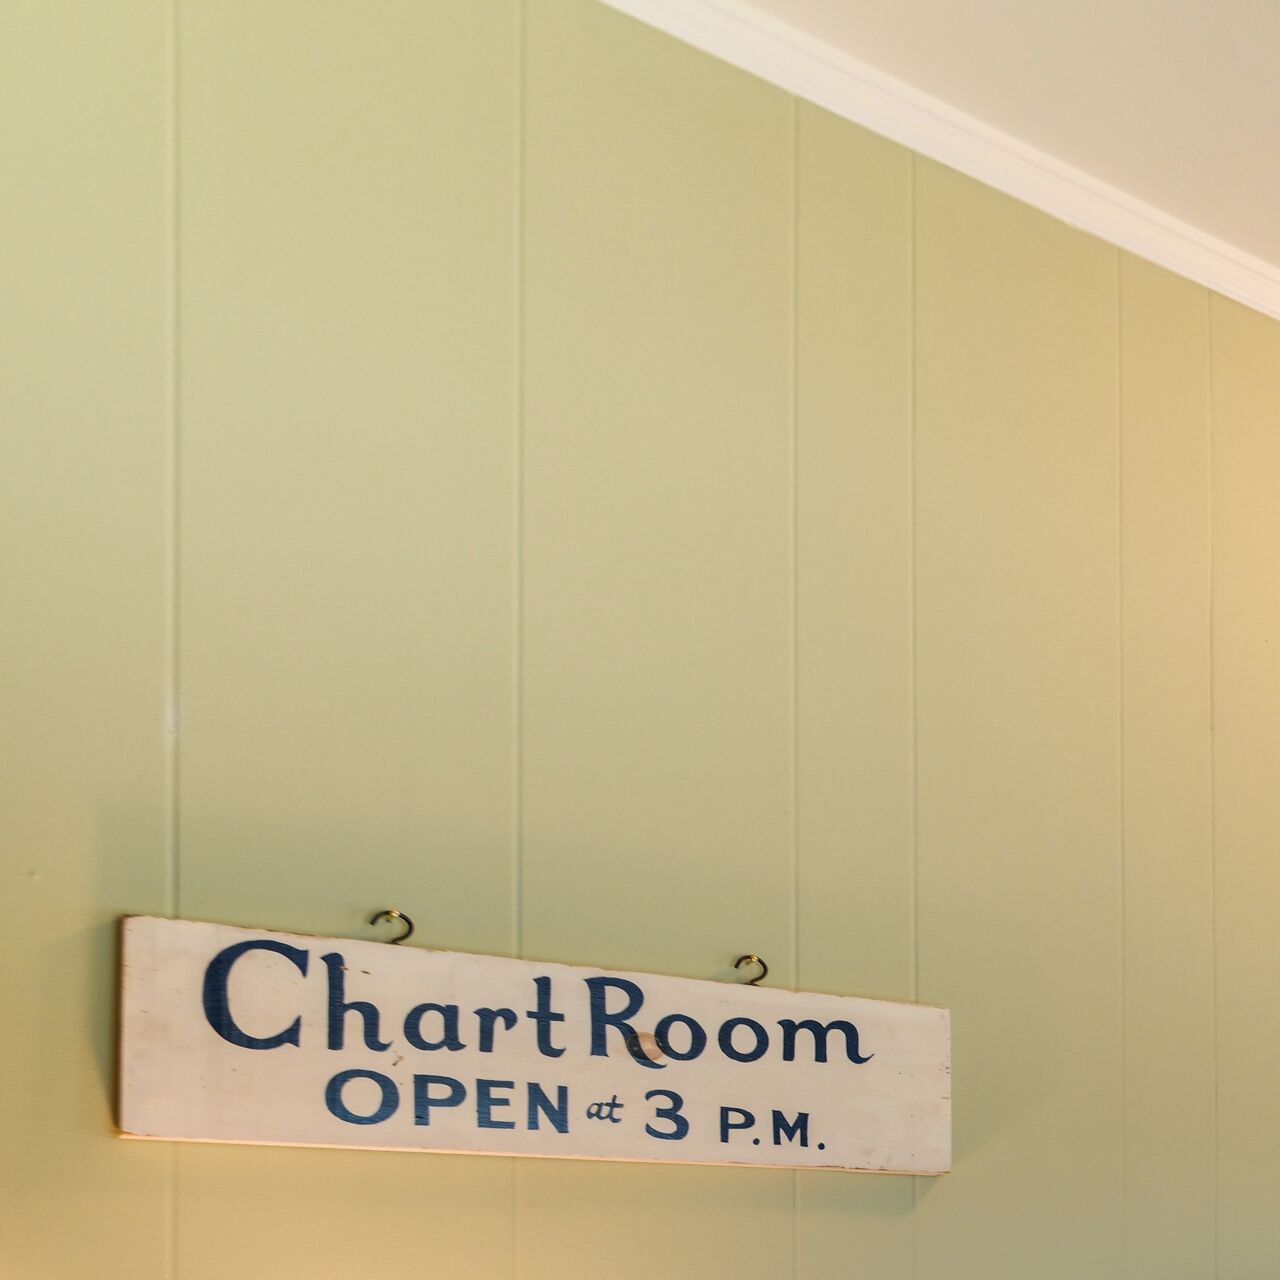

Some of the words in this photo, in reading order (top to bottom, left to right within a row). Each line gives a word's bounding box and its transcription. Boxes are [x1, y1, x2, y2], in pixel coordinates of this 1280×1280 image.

[203, 940, 566, 1058] Chart
[585, 975, 874, 1070] Room
[324, 1069, 569, 1134] OPEN
[586, 1094, 624, 1125] at
[644, 1089, 689, 1141] 3
[719, 1106, 825, 1152] P.M.
